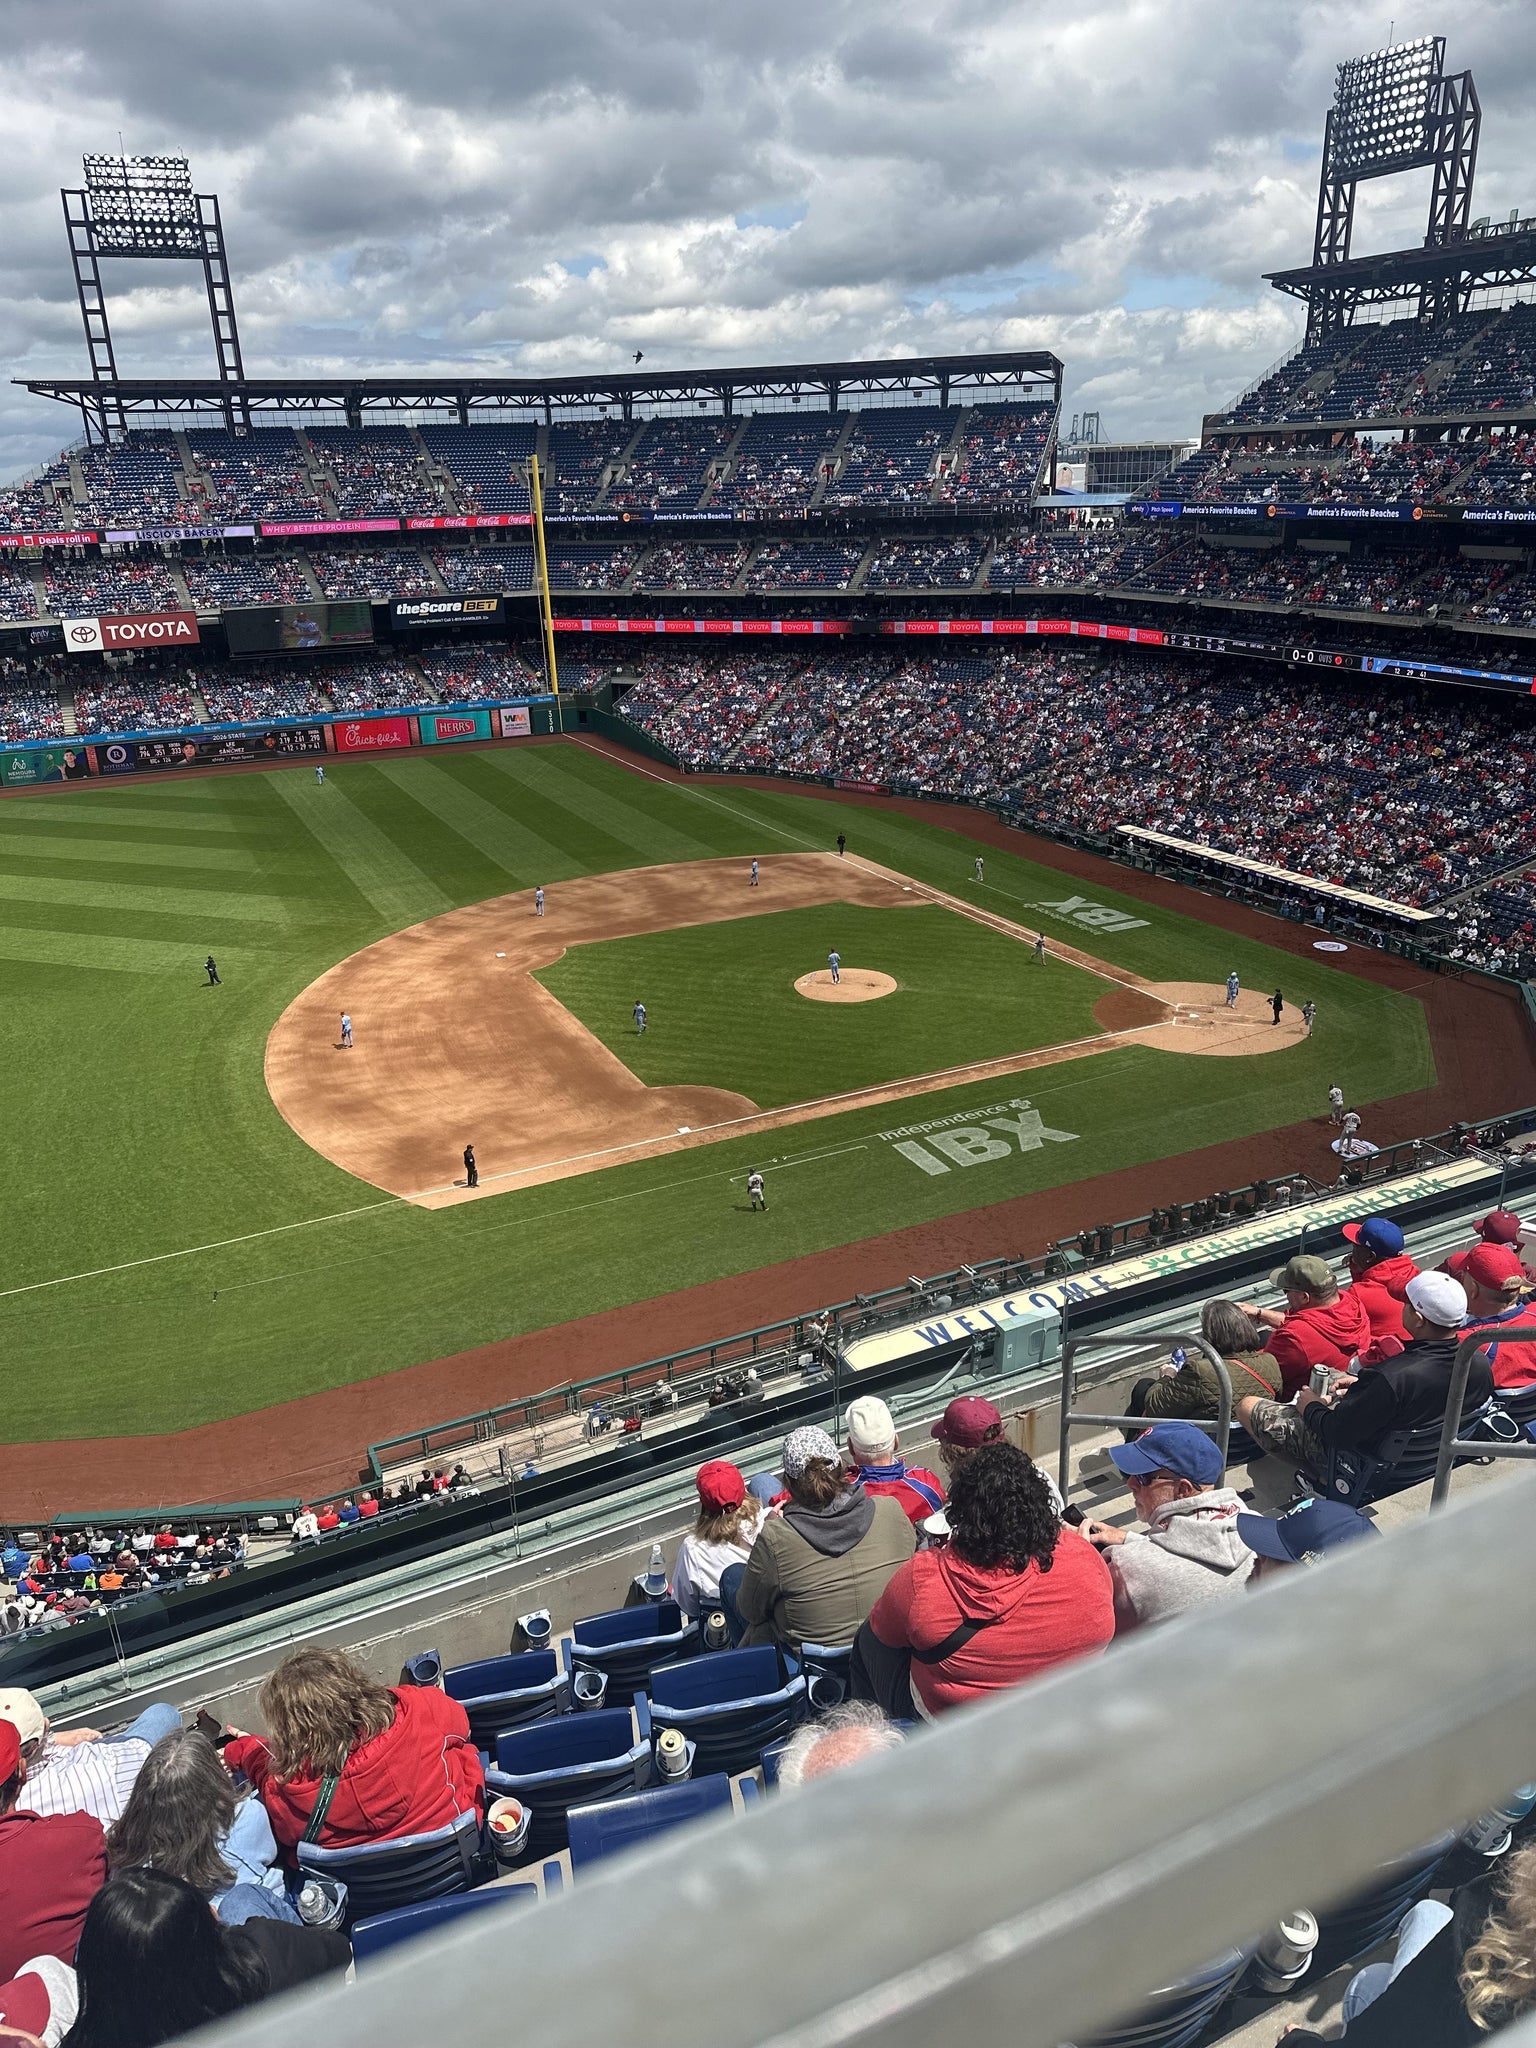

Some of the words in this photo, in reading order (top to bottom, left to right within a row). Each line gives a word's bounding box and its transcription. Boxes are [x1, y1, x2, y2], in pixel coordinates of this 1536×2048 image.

[1182, 506, 1209, 514] America's
[1209, 506, 1233, 515] Favorite
[1233, 507, 1258, 515] Beaches
[1307, 507, 1339, 517] America's
[1340, 508, 1369, 517] Favorite
[1370, 509, 1400, 518] Beaches
[1462, 510, 1503, 520] America's
[476, 516, 500, 526] Coca-Cola
[507, 515, 531, 525] Coca-Cola
[572, 514, 595, 522] Favorite
[653, 513, 682, 521] America's
[411, 519, 435, 529] Coca-Cola
[444, 518, 467, 527] Coca-Cola
[265, 525, 291, 533] WHEY
[293, 525, 324, 533] BETTER
[326, 523, 361, 532] PROTEIN
[136, 529, 181, 540] LISCIO'S
[184, 528, 226, 538] BAKERY
[1, 538, 18, 546] win
[39, 535, 64, 544] Deals
[66, 535, 81, 543] roll
[396, 602, 462, 615] theScore
[466, 601, 494, 611] BET
[105, 621, 192, 641] TOYOTA
[667, 622, 691, 630] TOYOTA
[952, 623, 979, 631] TOYOTA
[995, 623, 1023, 631] TOYOTA
[1079, 625, 1098, 634] TOYOTA
[1108, 628, 1128, 637] TOYOTA
[1139, 631, 1159, 641] TOYOTA
[1318, 653, 1332, 664] OUTS
[504, 714, 526, 723] WM
[440, 721, 471, 733] HERR'S
[345, 726, 401, 747] Chick-fil-A
[877, 1103, 1009, 1141] Independence
[892, 1109, 1081, 1176] IBX
[1180, 1219, 1301, 1266] Citizens
[1304, 1195, 1388, 1230] Bank
[1375, 1176, 1451, 1207] Park
[1120, 1271, 1140, 1282] TO
[305, 1524, 311, 1532] 3
